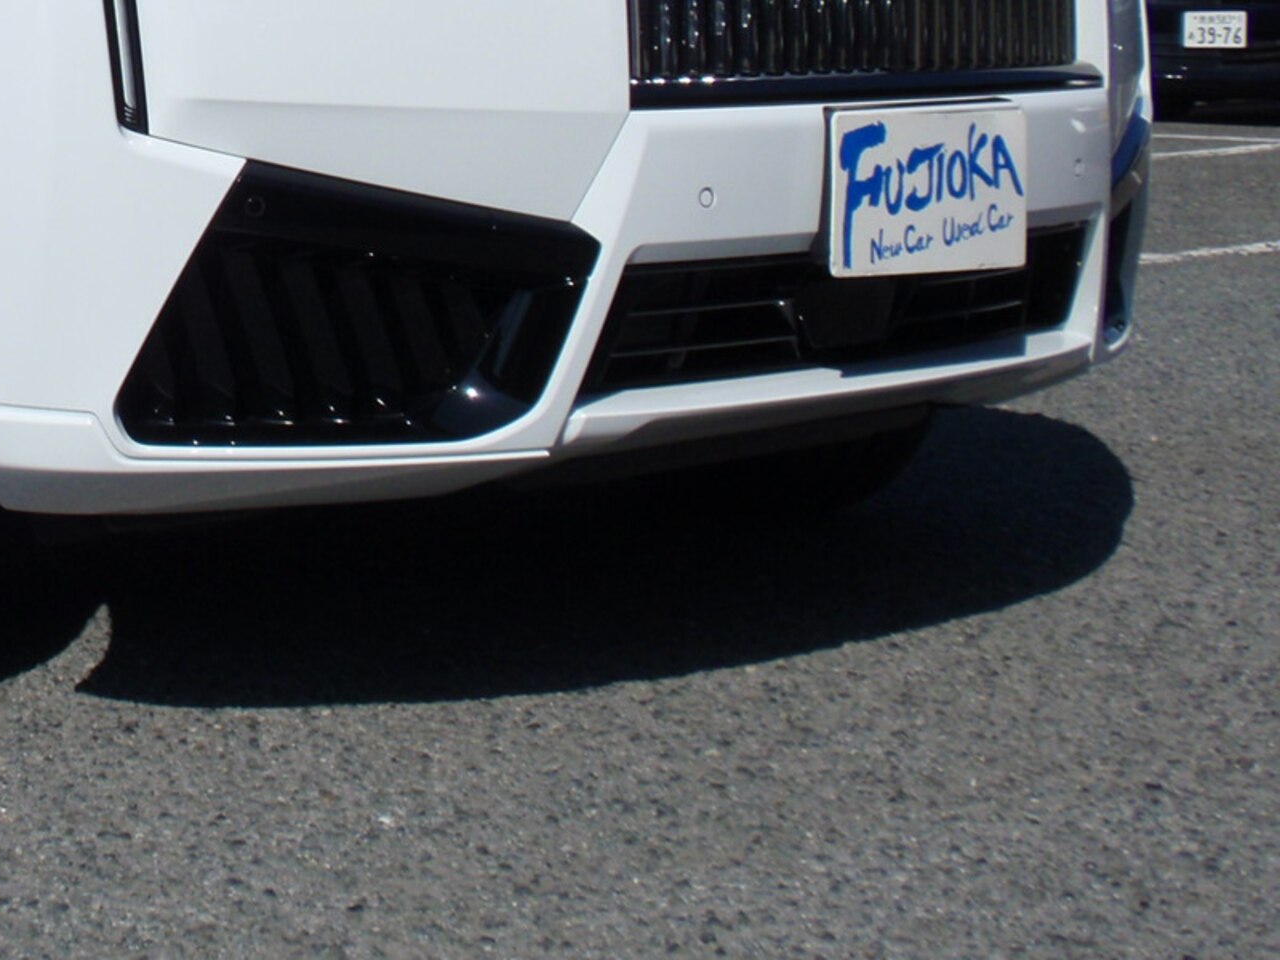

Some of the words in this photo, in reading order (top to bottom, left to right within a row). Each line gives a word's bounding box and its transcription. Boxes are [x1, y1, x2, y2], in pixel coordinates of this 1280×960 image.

[840, 120, 1024, 269] FUJIOKA
[870, 229, 903, 264] New
[904, 224, 933, 253] Car
[942, 212, 983, 246] Used
[987, 203, 1014, 232] Car
